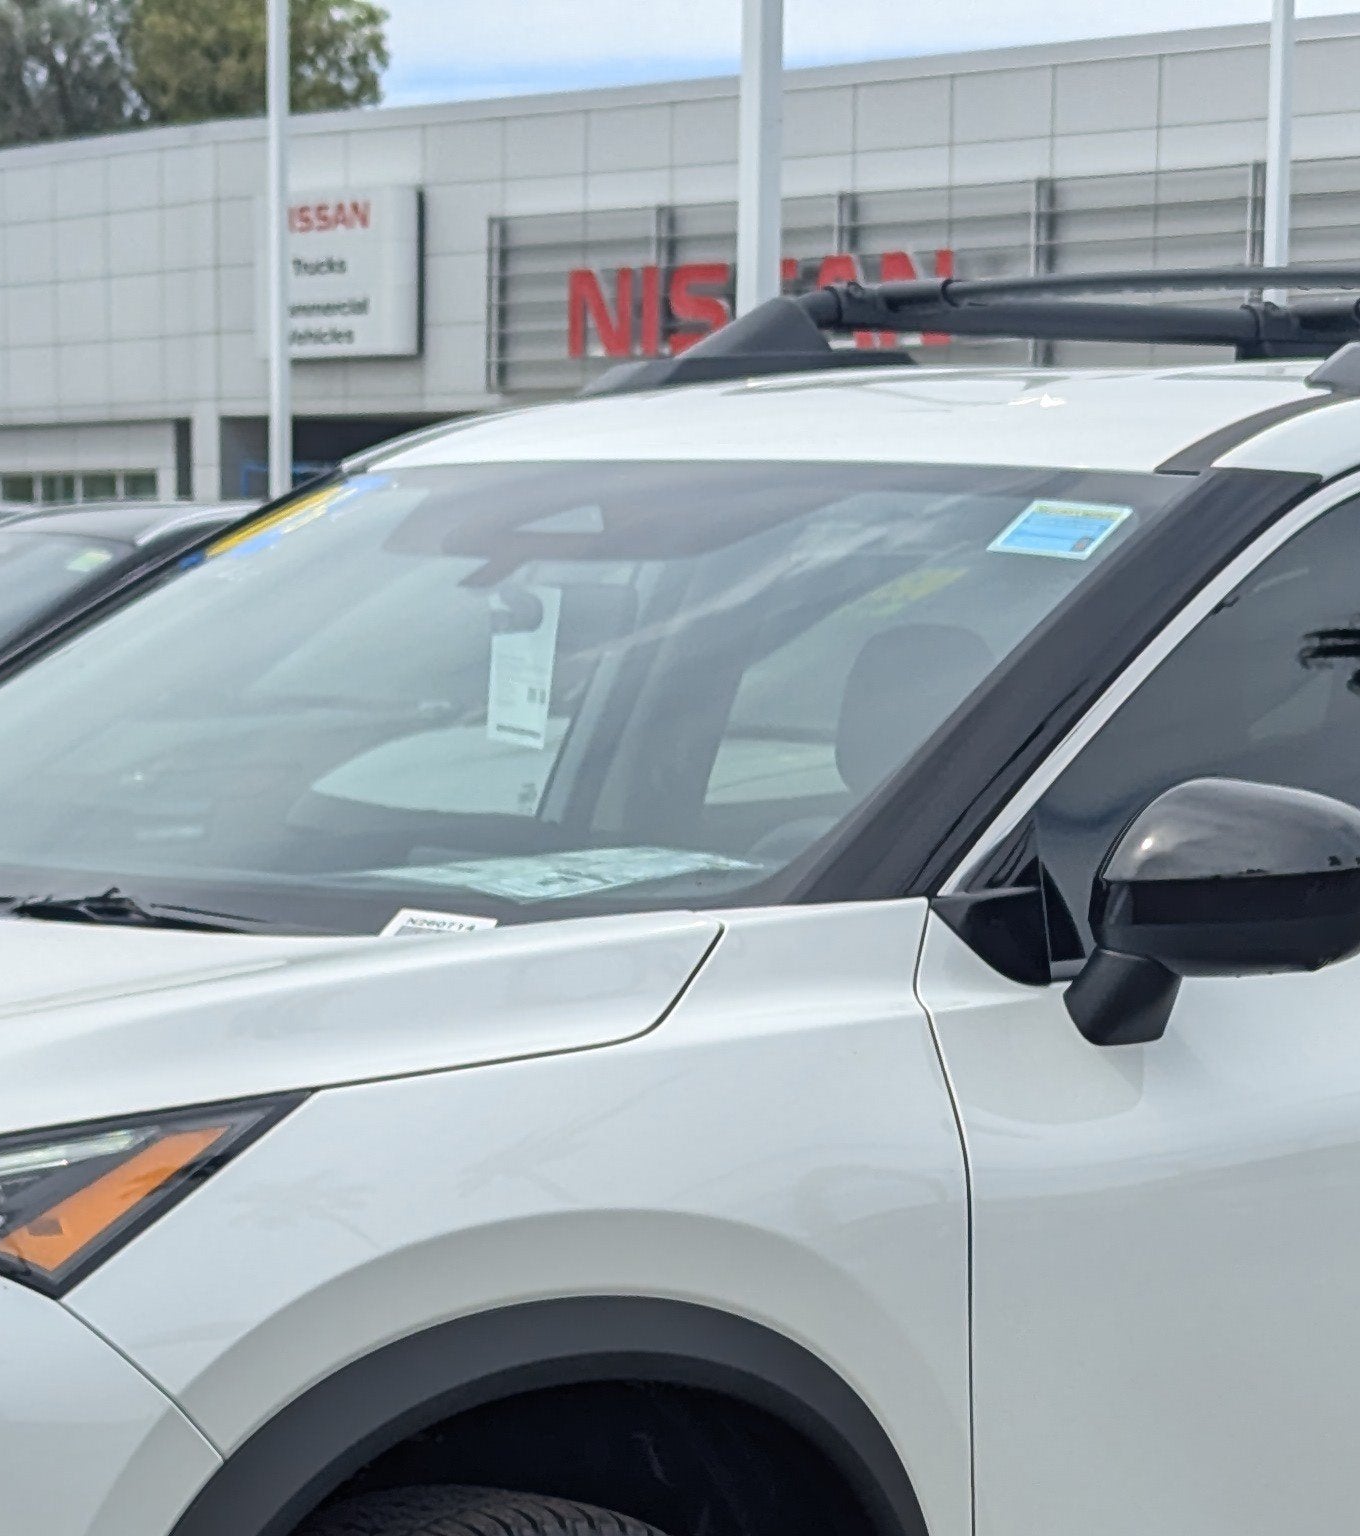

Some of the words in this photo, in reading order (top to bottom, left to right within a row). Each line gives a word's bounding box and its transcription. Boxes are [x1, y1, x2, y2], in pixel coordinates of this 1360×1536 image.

[287, 201, 372, 234] ISSAN
[292, 257, 348, 277] Trucks
[288, 298, 371, 319] ommercial
